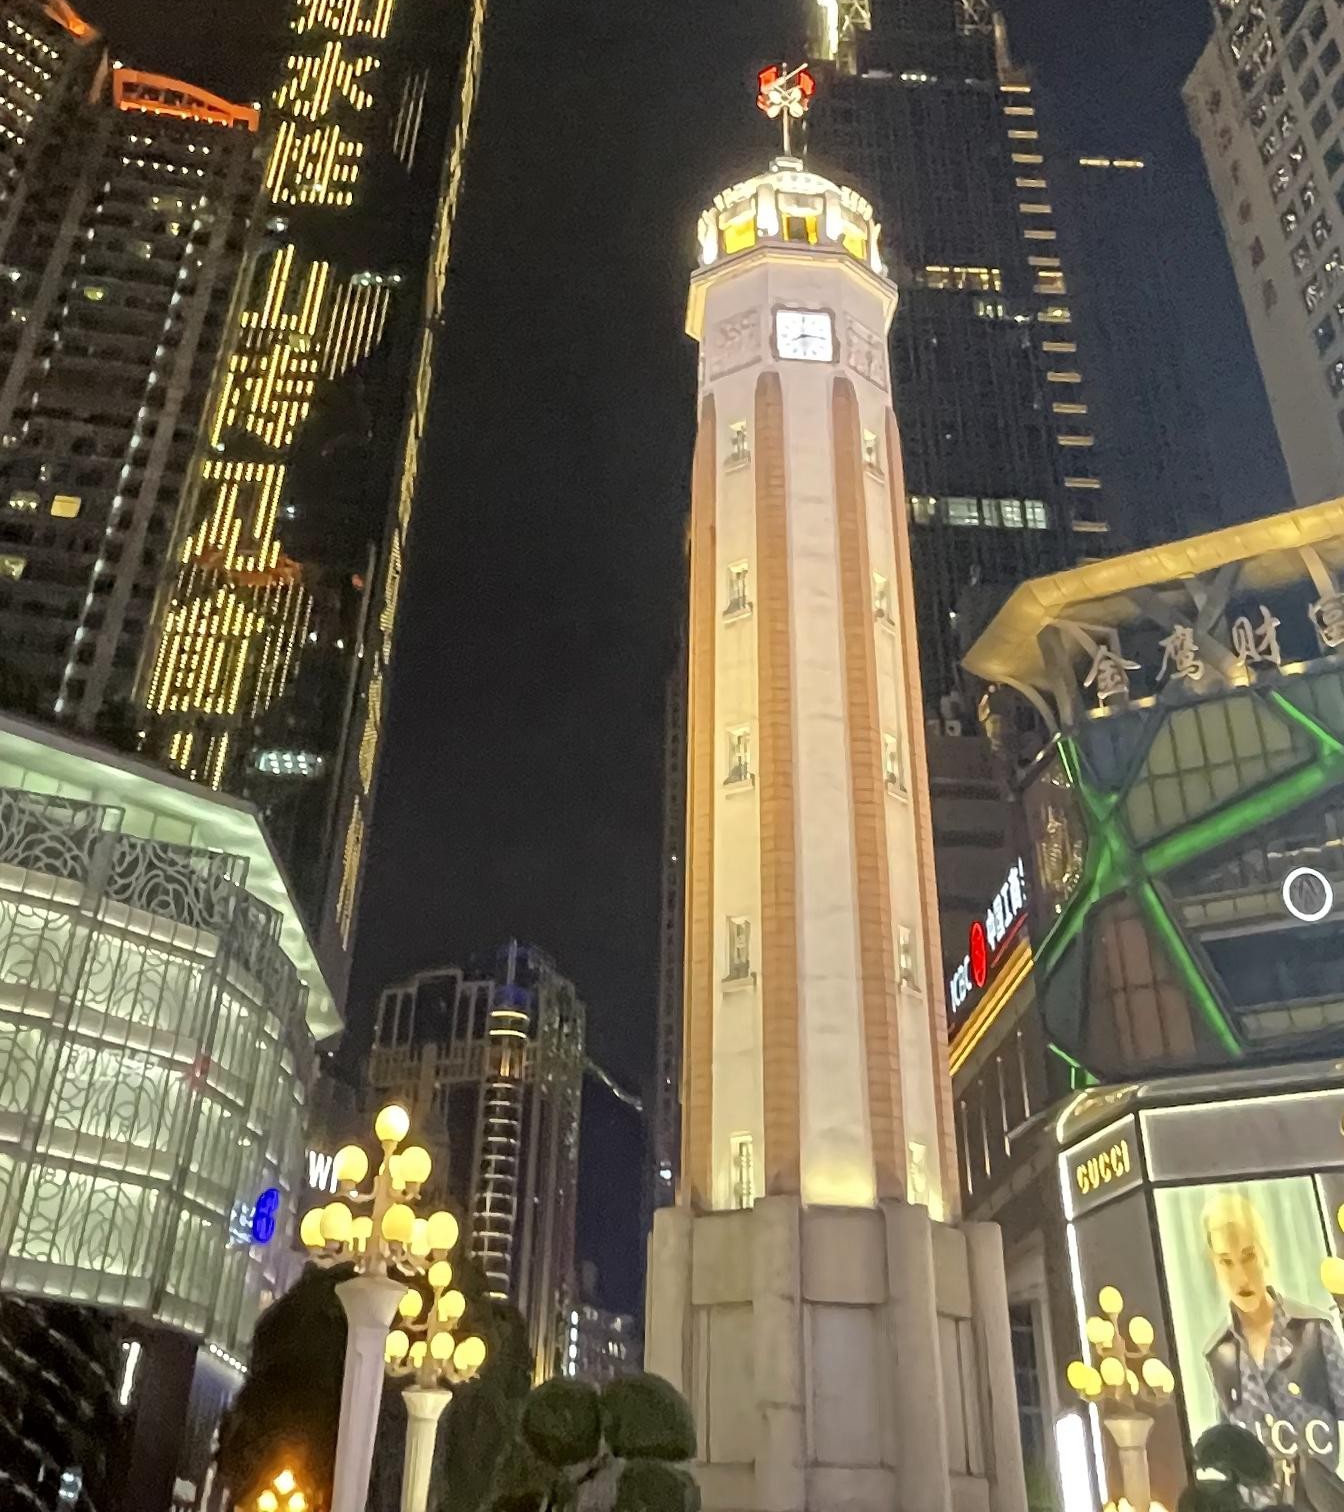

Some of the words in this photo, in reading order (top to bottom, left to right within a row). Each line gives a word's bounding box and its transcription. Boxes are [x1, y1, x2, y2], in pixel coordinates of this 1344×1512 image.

[985, 855, 1027, 951] 中国工商
[1076, 1138, 1131, 1195] GUCCI
